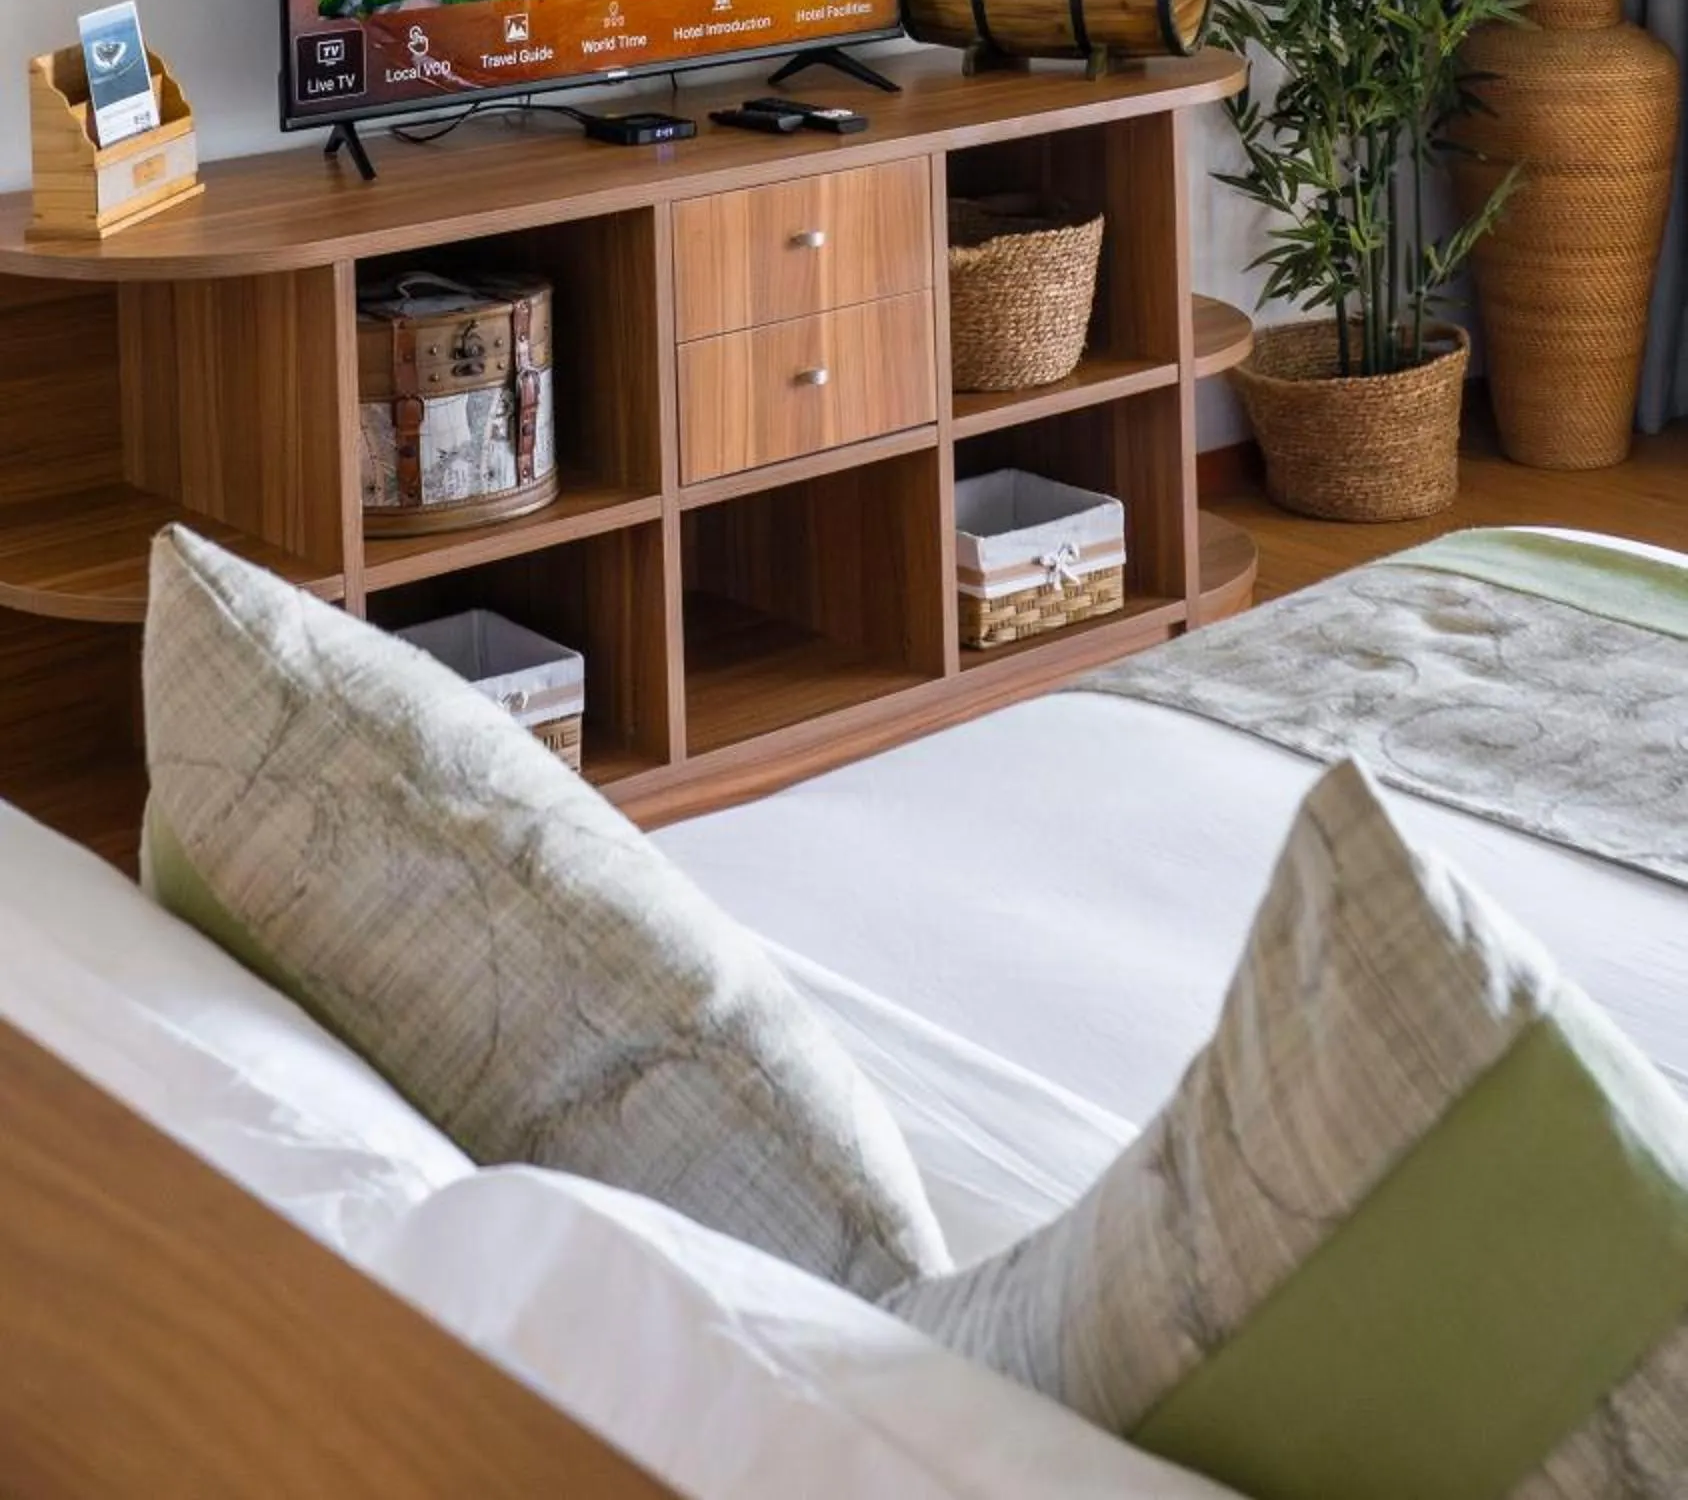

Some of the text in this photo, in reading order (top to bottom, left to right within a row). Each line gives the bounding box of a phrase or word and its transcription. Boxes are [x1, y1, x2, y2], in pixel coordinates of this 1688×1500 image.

[796, 2, 873, 22] Hotel Facilities
[673, 16, 772, 41] Hotel Introduction
[323, 46, 339, 58] TV
[581, 33, 648, 54] World Time
[480, 46, 554, 69] Travel Guide
[307, 73, 356, 94] Live TV
[385, 66, 420, 83] Local
